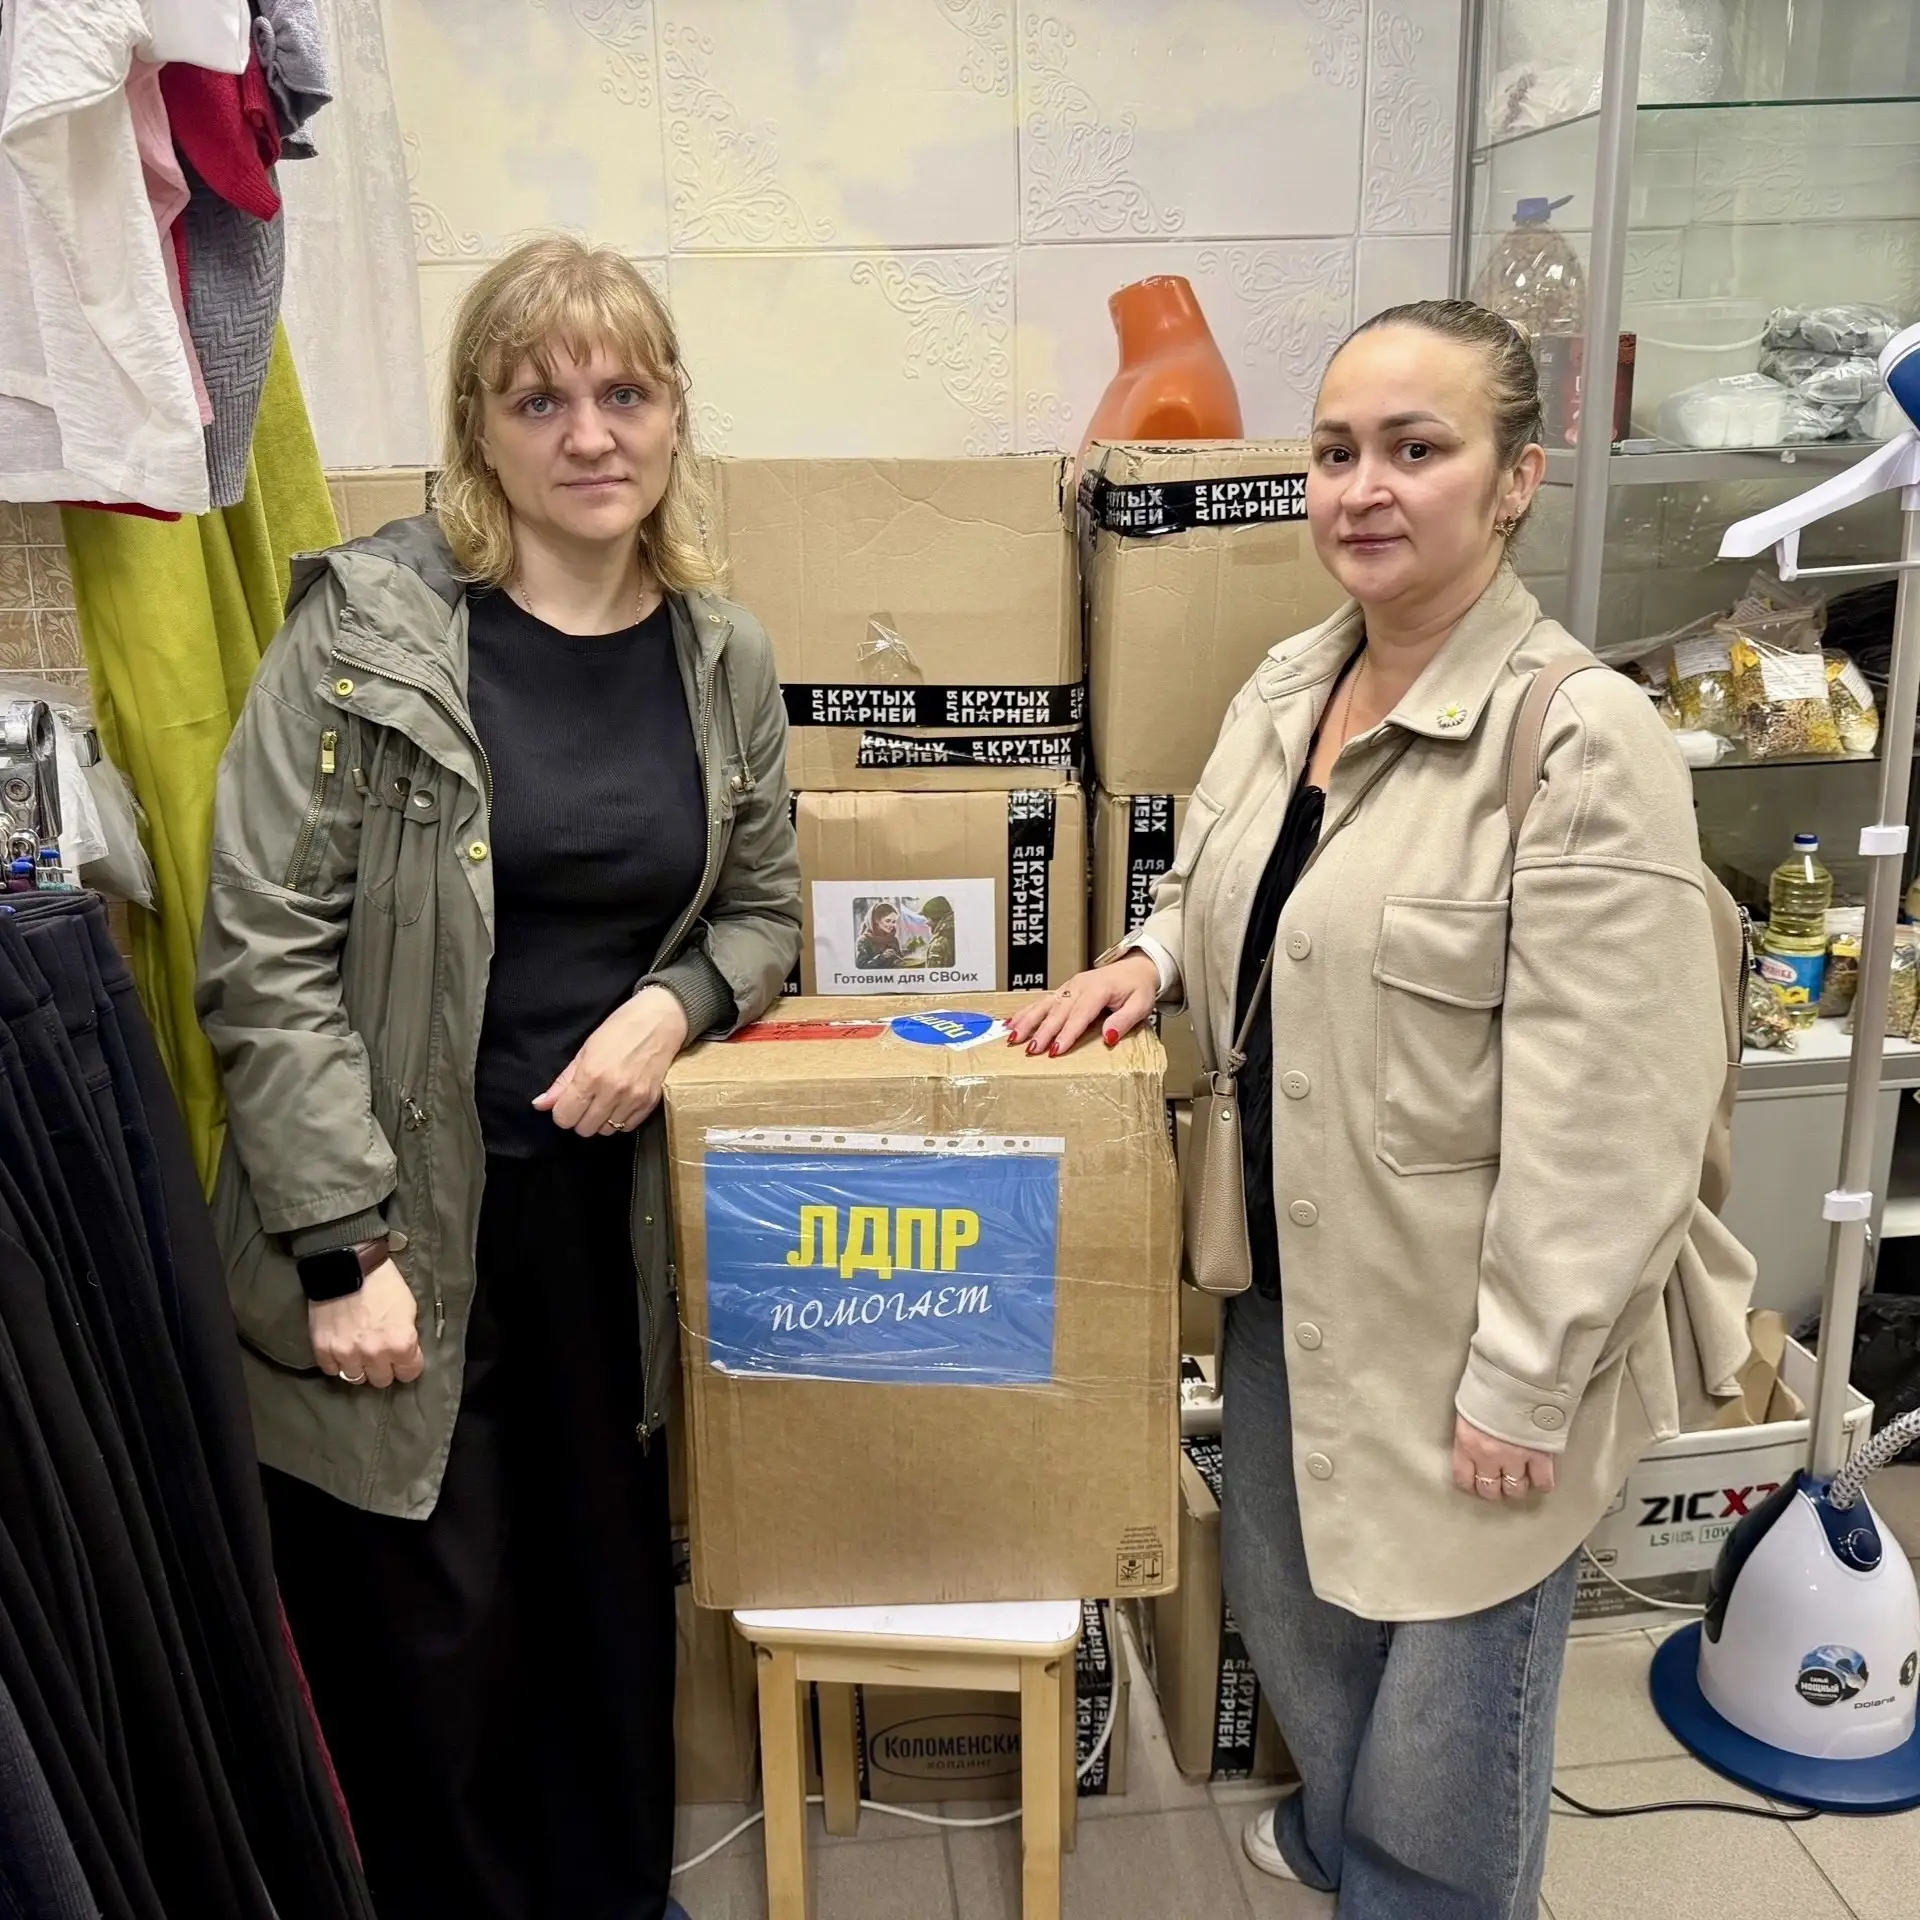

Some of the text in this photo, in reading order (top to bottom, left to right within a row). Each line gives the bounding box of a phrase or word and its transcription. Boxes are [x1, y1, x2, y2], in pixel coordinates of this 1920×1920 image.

[1212, 479, 1305, 501] КРУТЫХ
[827, 690, 916, 706] КРУТЫХ
[961, 691, 1050, 706] КРУТЫХ
[987, 737, 1072, 756] КРУТЫХ
[1029, 861, 1045, 945] КРУТЫХ
[834, 970, 978, 985] Готовим для СВОих
[787, 1205, 980, 1279] ЛДПР
[1704, 1526, 1734, 1540] 10W
[1234, 1672, 1255, 1748] КРУТЫХ
[884, 1734, 1020, 1759] КОЛОМЕНСКИ
